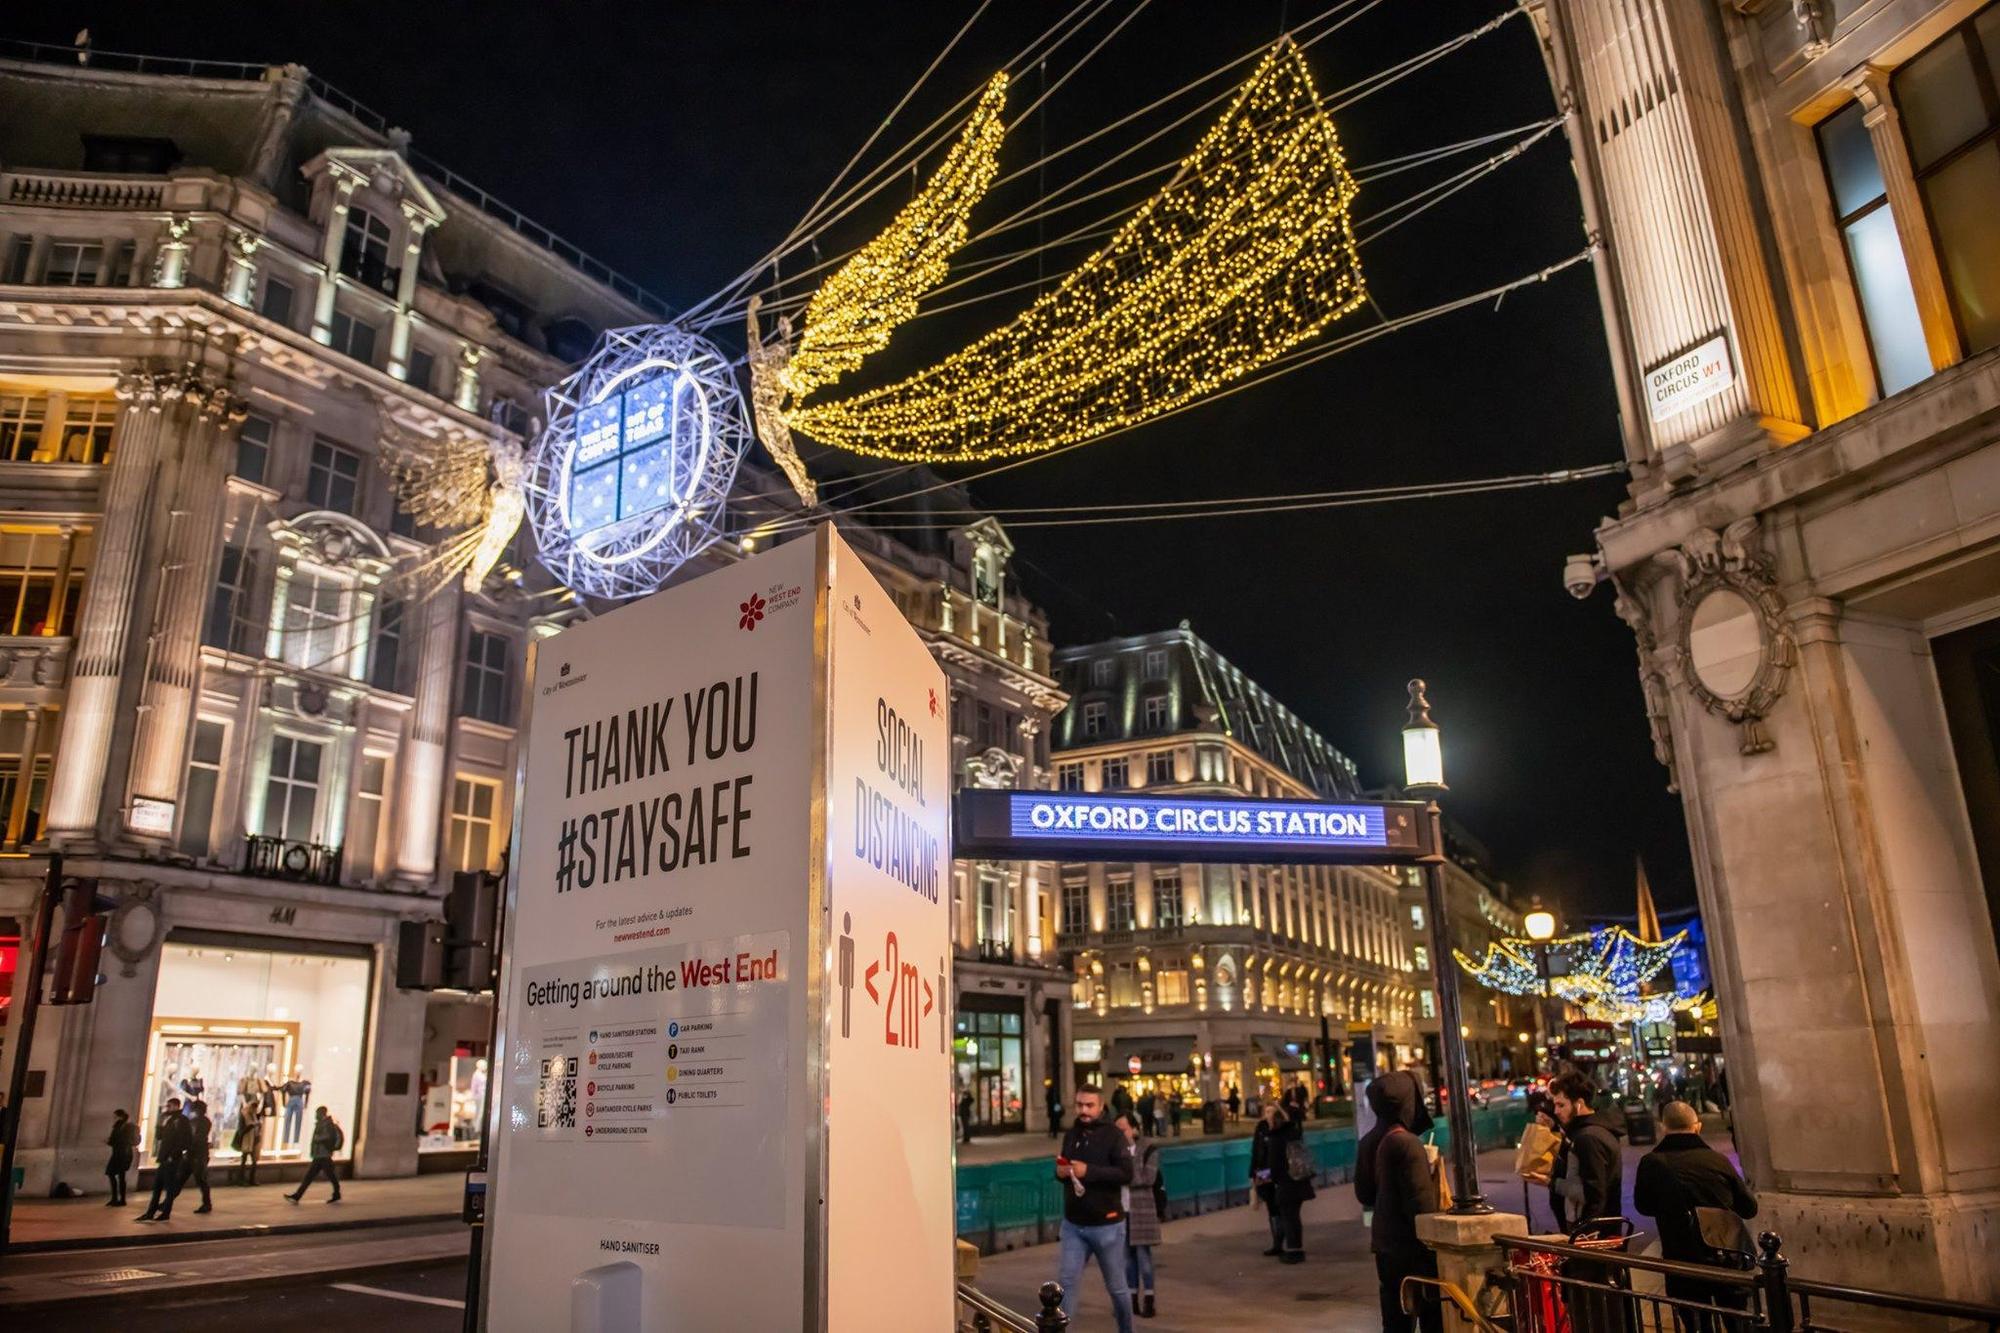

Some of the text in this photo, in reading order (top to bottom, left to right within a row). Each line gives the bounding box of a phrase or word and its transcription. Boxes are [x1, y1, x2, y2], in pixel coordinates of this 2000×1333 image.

[1653, 355, 1699, 387] OXFORD
[1656, 372, 1699, 402] CIRCUS
[1702, 360, 1721, 378] W1
[768, 586, 801, 604] WEST END
[768, 598, 799, 614] COMPANY
[564, 671, 758, 799] THANK YOU
[877, 697, 926, 807] SOCIAL
[1030, 804, 1367, 836] OXFORD CIRCUS STATION
[556, 775, 753, 893] #STAYSAFE
[855, 776, 939, 905] DISTANCING
[595, 906, 693, 929] For the latest advice & updates
[614, 926, 671, 942] newwestend.com
[527, 949, 778, 1009] Getting around the West End
[635, 1028, 656, 1036] STATIONS
[680, 1023, 712, 1032] CAR PARKING
[611, 1062, 632, 1070] PARKING
[697, 1067, 723, 1075] QUARTERS
[615, 1083, 635, 1091] PARKING
[678, 1090, 718, 1099] PUBLIC TOILETS
[600, 1240, 660, 1255] HAND SANITISER
